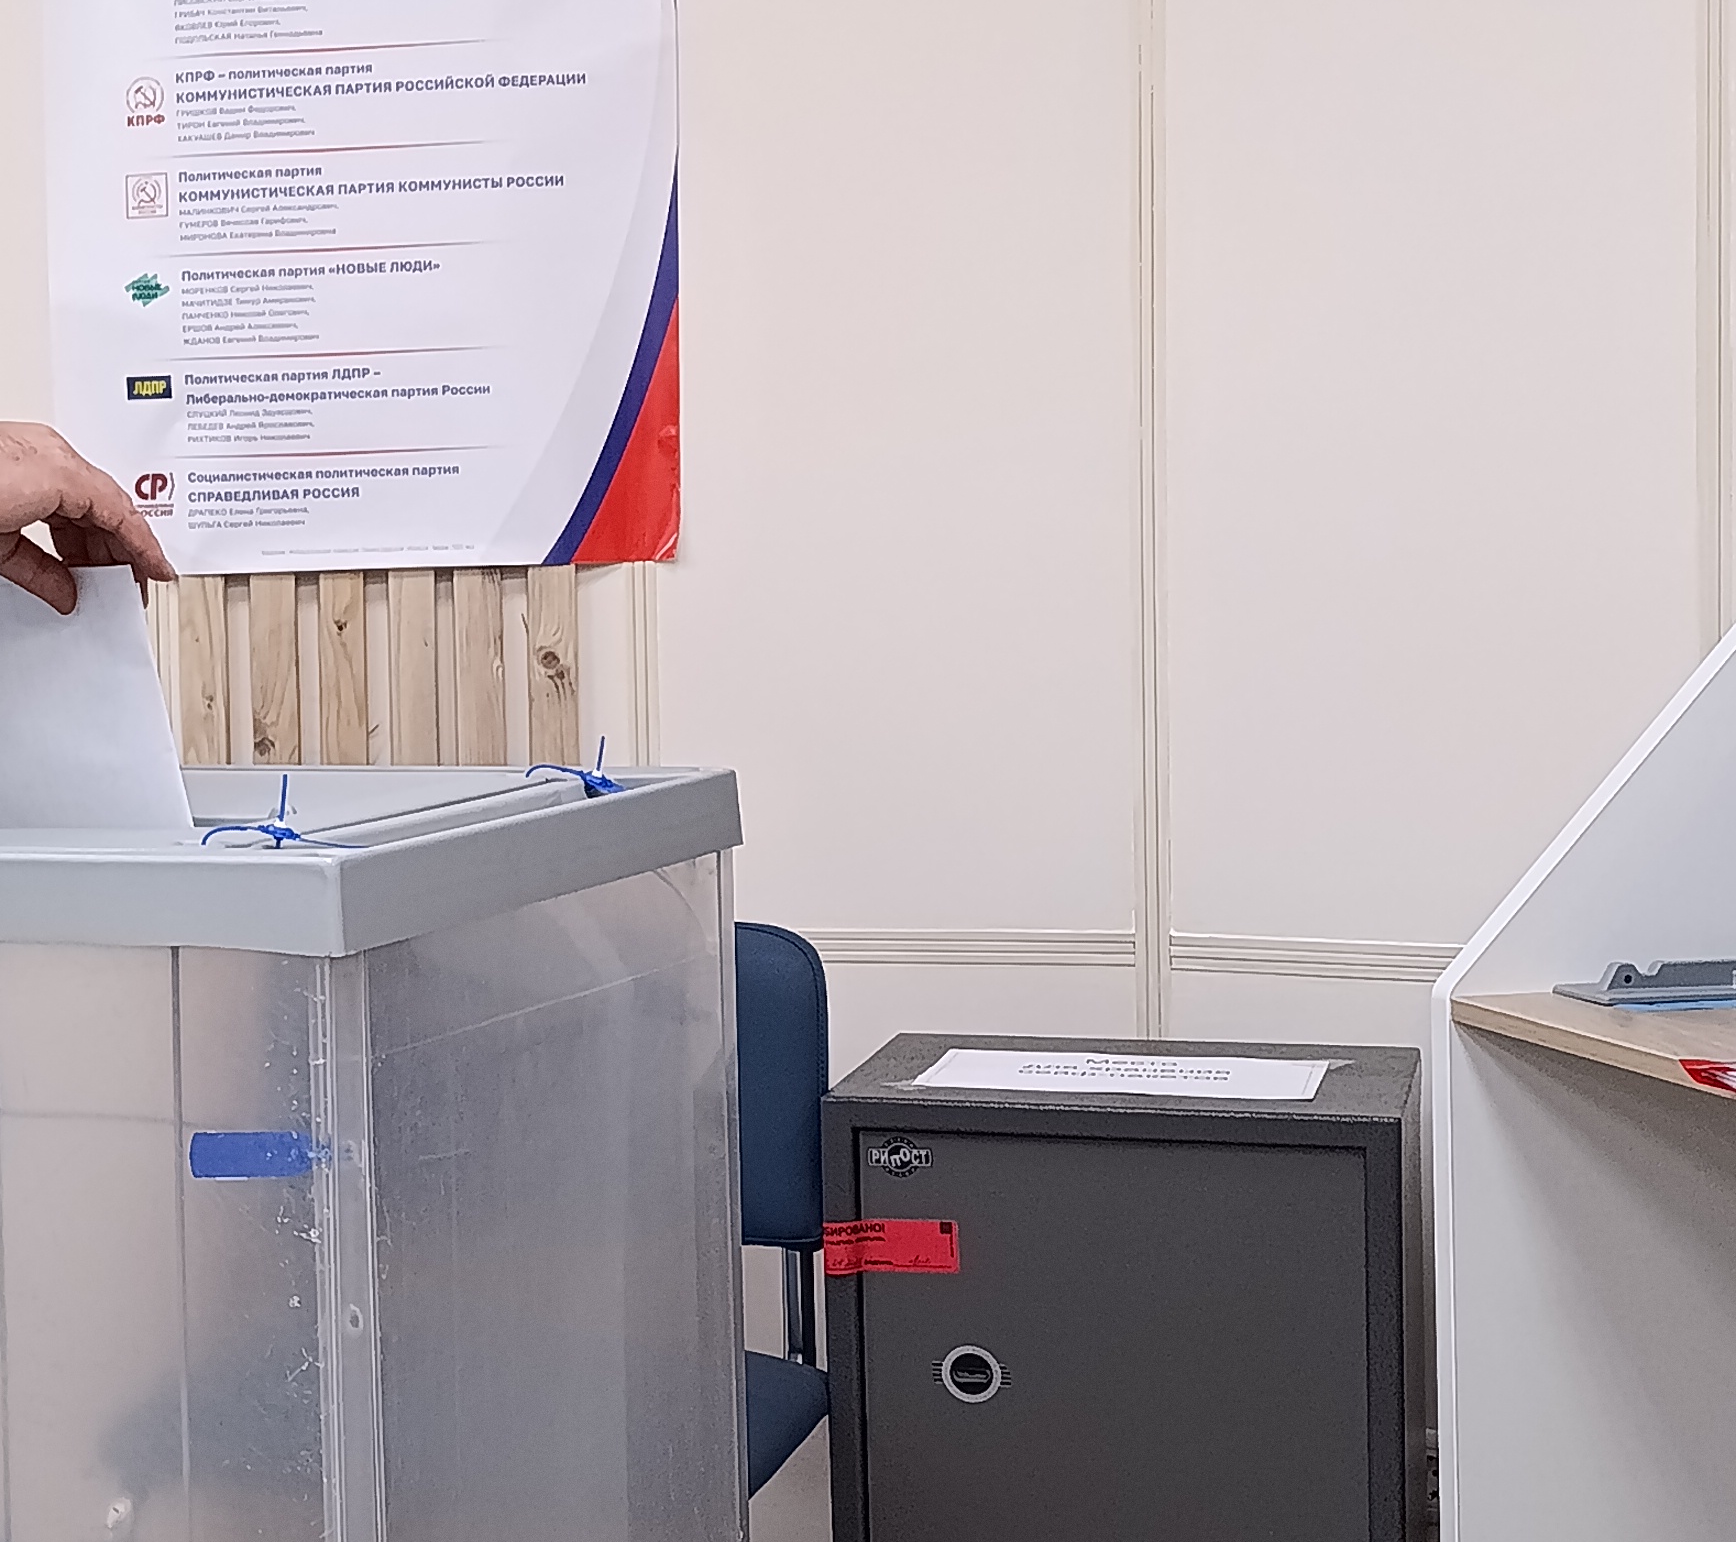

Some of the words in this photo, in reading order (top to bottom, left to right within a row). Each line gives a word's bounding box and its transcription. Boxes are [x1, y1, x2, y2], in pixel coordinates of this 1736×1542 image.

[175, 70, 215, 83] КПРФ
[228, 67, 322, 79] политическая
[325, 64, 372, 77] партия
[175, 84, 332, 103] КОММУНИСТИЧЕСКАЯ
[335, 81, 392, 95] ПАРТИЯ
[395, 74, 495, 91] РОССИЙСКОЙ
[497, 73, 586, 88] ФЕДЕРАЦИИ
[127, 114, 166, 128] КПРФ
[178, 169, 272, 182] Политическая
[275, 167, 322, 179] партия
[178, 184, 334, 202] КОММУНИСТИЧЕСКАЯ
[338, 181, 394, 195] ПАРТИЯ
[398, 177, 503, 192] КОММУНИСТЫ
[506, 175, 564, 187] РОССИИ
[181, 268, 276, 281] Политическая
[278, 266, 325, 278] партия
[328, 261, 387, 274] «НОВЫЕ
[389, 260, 441, 273] ЛЮДИ»
[184, 373, 279, 385] Политическая
[281, 371, 329, 383] партия
[331, 367, 370, 380] ЛДПР
[132, 380, 167, 397] ЛДПР
[185, 389, 388, 405] Либерально-демократическая
[391, 387, 438, 399] партия
[441, 384, 490, 395] России
[187, 470, 313, 483] Социалистическая
[315, 467, 409, 479] политическая
[412, 465, 459, 477] партия
[134, 472, 169, 502] СР
[187, 488, 299, 502] СПРАВЕДЛИВАЯ
[302, 486, 360, 499] РОССИЯ
[138, 508, 174, 518] ОССИЯ
[871, 1149, 927, 1168] РИПОСТ
